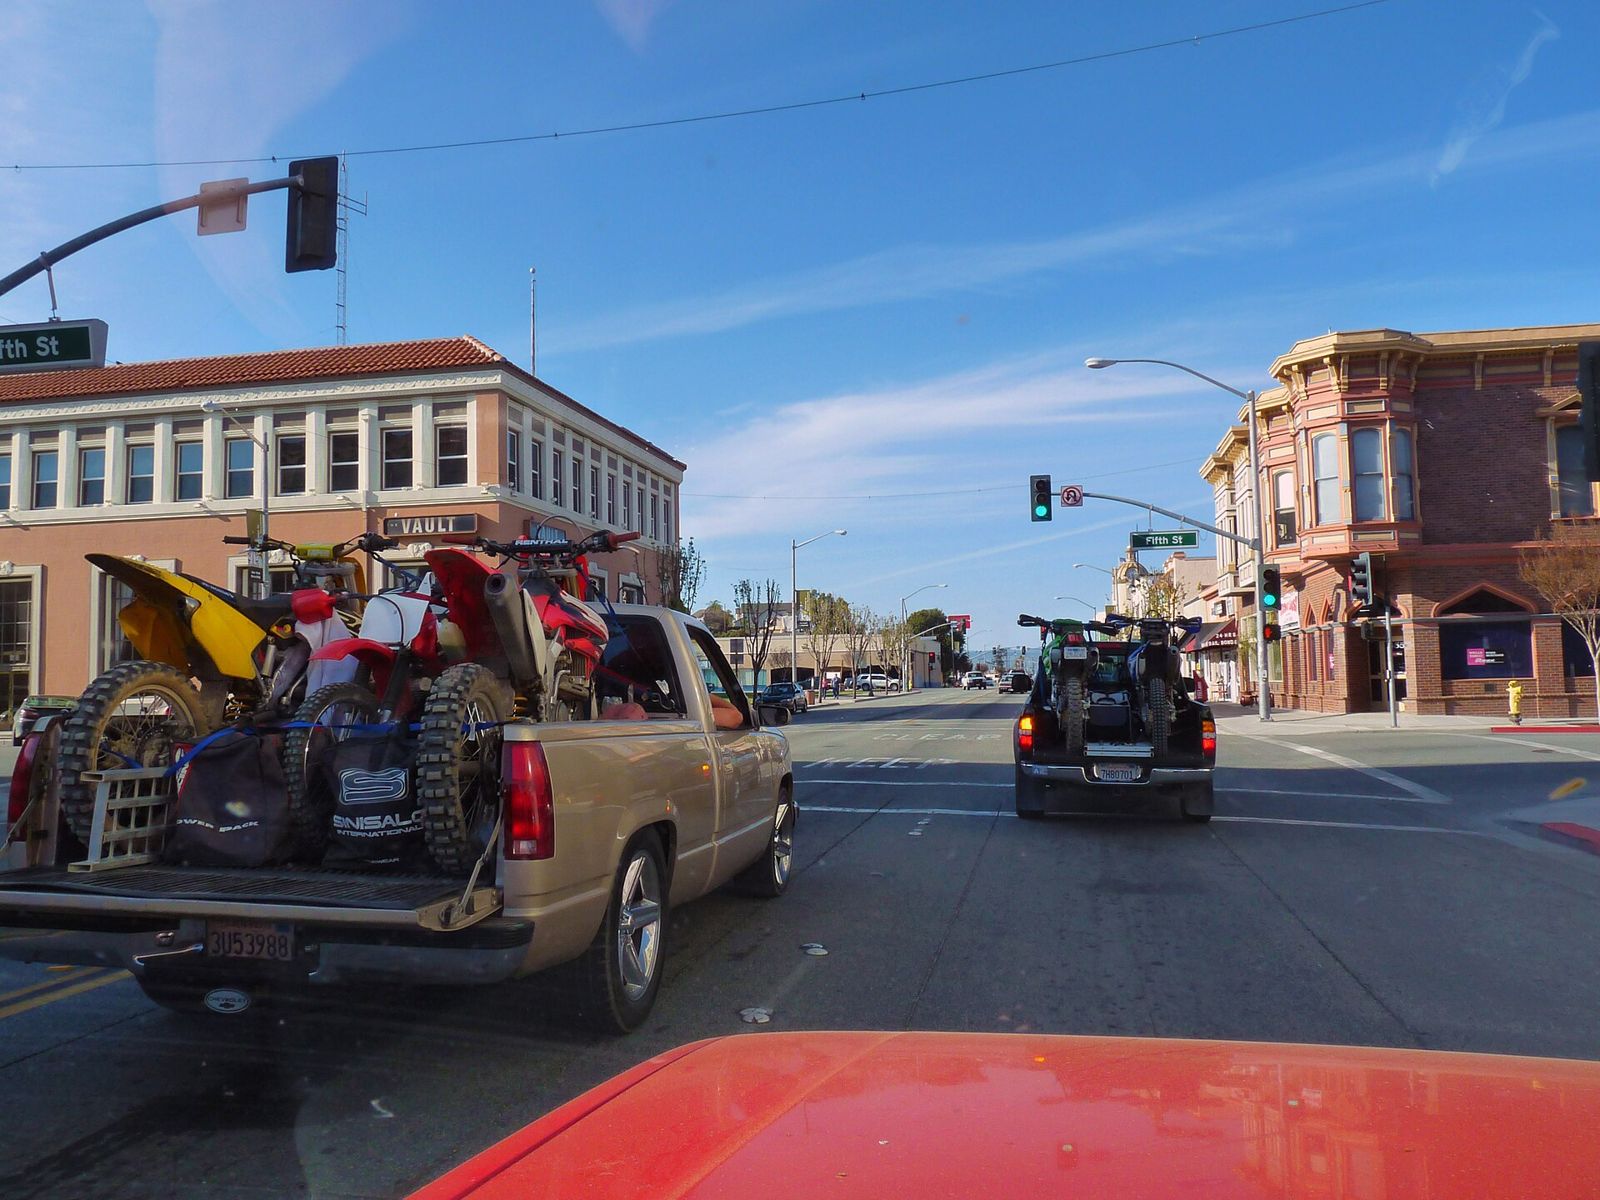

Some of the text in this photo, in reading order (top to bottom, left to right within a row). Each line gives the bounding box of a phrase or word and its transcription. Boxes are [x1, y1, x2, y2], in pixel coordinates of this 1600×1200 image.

[36, 335, 60, 357] St
[401, 516, 456, 534] VAULT
[1146, 535, 1184, 545] Fifth St
[211, 931, 289, 958] 3U53988
